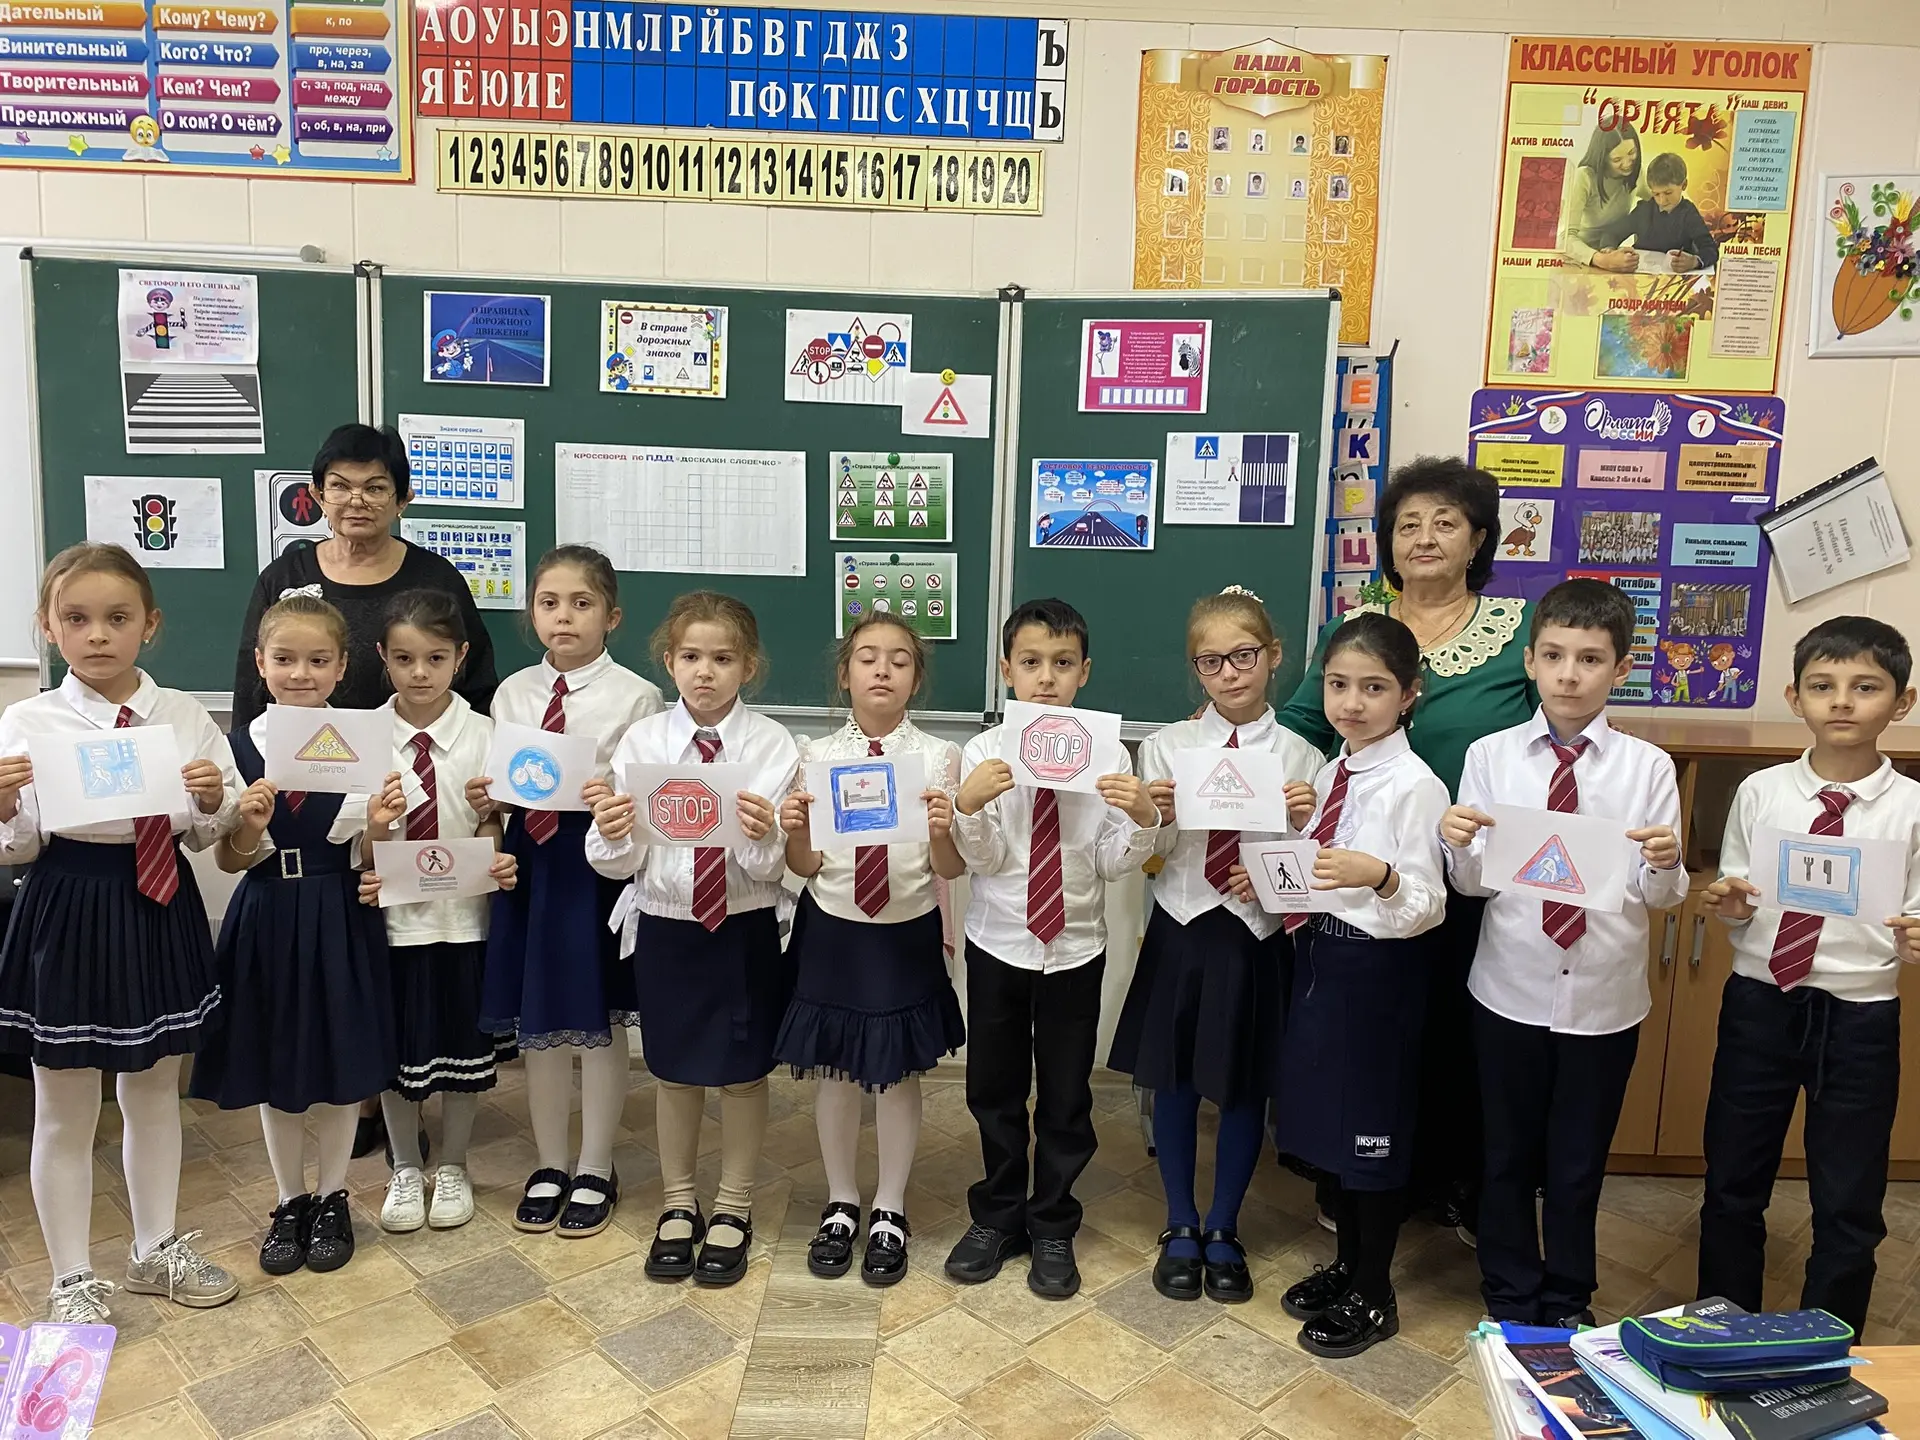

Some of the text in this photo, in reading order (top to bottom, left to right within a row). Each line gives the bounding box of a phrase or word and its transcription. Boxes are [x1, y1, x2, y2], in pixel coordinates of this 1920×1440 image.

[0, 3, 104, 22] Дательный
[160, 8, 266, 31] Кому? Чему?
[325, 17, 352, 27] к, по
[0, 38, 128, 58] Винительный
[160, 42, 252, 62] Кого? Что?
[309, 46, 372, 58] про, через,
[318, 60, 364, 70] в, на, за
[1233, 54, 1303, 73] НАША
[1520, 42, 1800, 79] КЛАССНЫЙ УГОЛОК
[0, 72, 139, 92] Творительный
[163, 78, 251, 97] Кем? Чем?
[301, 81, 383, 94] с, за, под, над,
[1213, 77, 1321, 97] ГОРДОСТЬ
[324, 94, 362, 106] между
[1741, 99, 1788, 111] НАШ ДЕВИЗ
[1, 105, 127, 126] Предложный
[163, 112, 277, 132] О ком? О чём?
[301, 120, 386, 135] о, об, в, на, при
[1511, 137, 1574, 148] АКТИВ КЛАССА
[643, 144, 670, 191] 10
[679, 145, 704, 192] 11
[714, 146, 742, 193] 12
[750, 148, 777, 195] 13
[785, 149, 813, 196] 14
[821, 150, 849, 197] 15
[857, 151, 884, 199] 16
[893, 153, 921, 200] 17
[932, 155, 960, 202] 18
[968, 156, 995, 203] 19
[1003, 157, 1031, 204] 20
[1724, 245, 1781, 257] НАША ПЕСНЯ
[1502, 257, 1564, 269] НАШИ ДЕЛА
[139, 279, 179, 287] СВЕТОФОР
[202, 283, 241, 291] СИГНАЛЫ
[480, 307, 531, 317] ПРАВИЛАХ
[472, 317, 532, 328] ДОРОЖНОГО
[640, 323, 688, 334] В стране
[475, 328, 529, 337] ДВИЖЕНИЯ
[636, 336, 692, 348] дорожных
[646, 349, 682, 359] знаков
[809, 346, 831, 355] STOP
[1602, 428, 1654, 440] РОССИИ
[574, 452, 627, 461] КРОССВОРД
[646, 454, 674, 463] ПДД
[1715, 451, 1732, 459] Быть
[1086, 463, 1149, 471] БЕЗОПАСНОСТИ
[1615, 578, 1656, 589] Октябрь
[1028, 731, 1083, 765] STOP
[308, 763, 347, 775] Дети
[657, 796, 712, 824] STOP
[1209, 799, 1245, 811] Дети
[1357, 1136, 1390, 1147] INSPIRE
[1750, 1388, 1797, 1408] EXTRA
[1770, 1397, 1815, 1419] ЦВЕТНЫЕ
